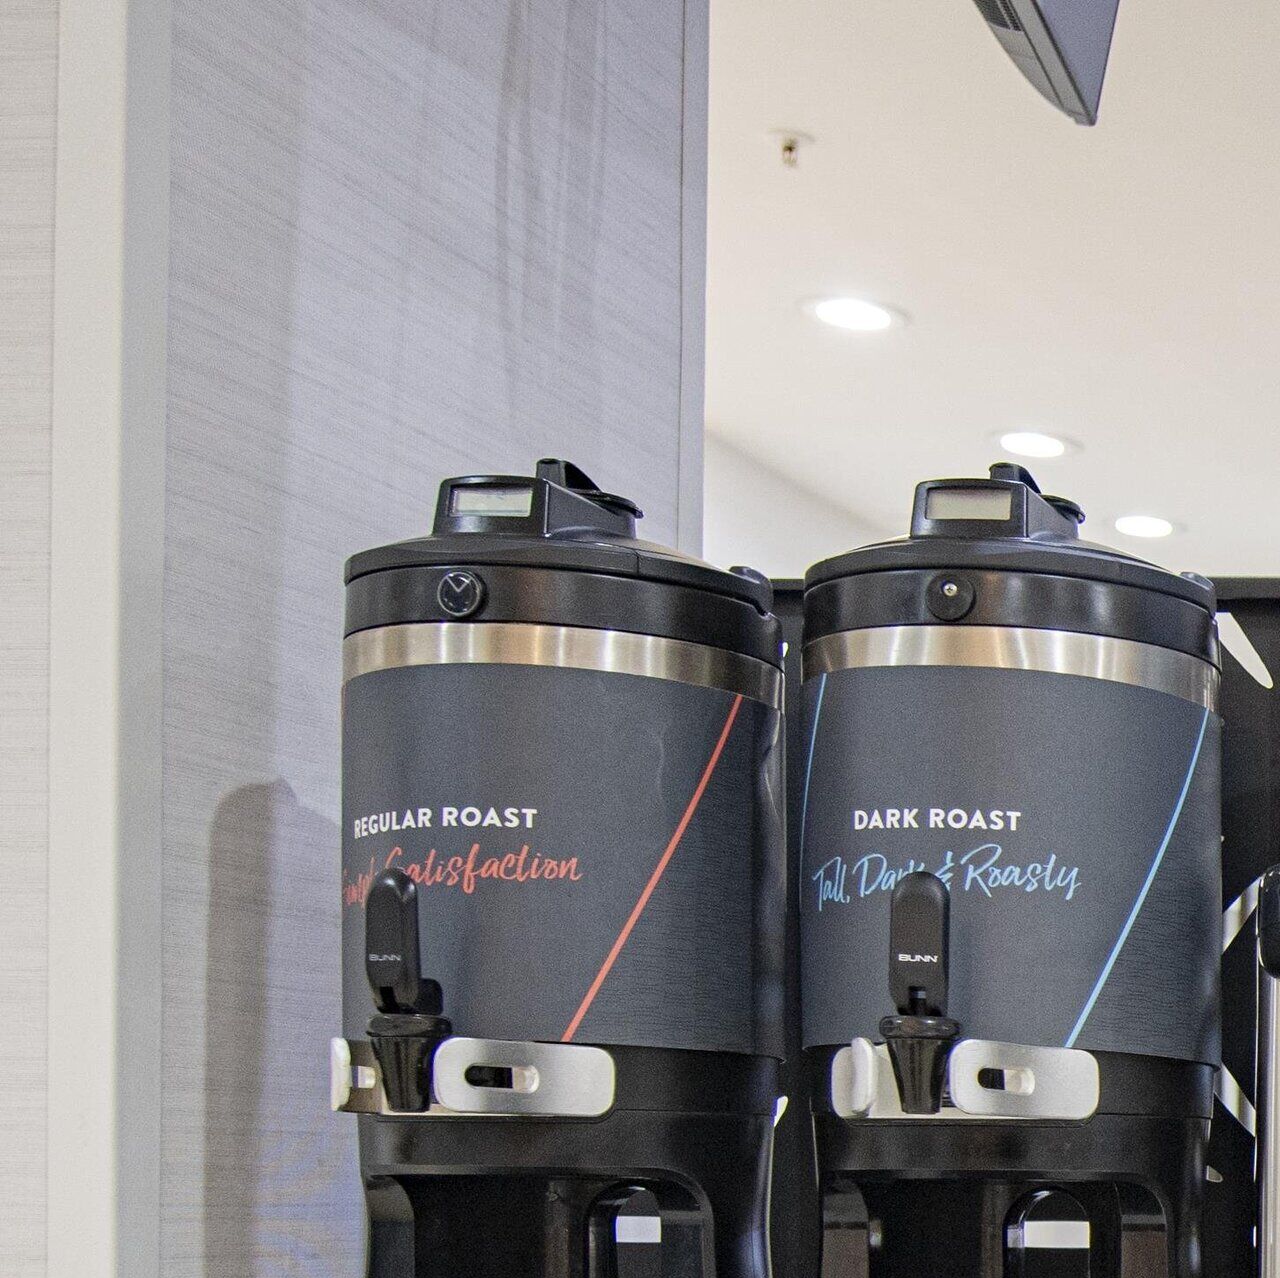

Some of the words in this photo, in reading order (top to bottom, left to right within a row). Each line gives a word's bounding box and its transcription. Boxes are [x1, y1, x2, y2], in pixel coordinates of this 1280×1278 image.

[354, 808, 433, 839] REGULAR
[442, 806, 538, 828] ROAST
[854, 808, 919, 831] DARK
[929, 808, 1021, 831] ROAST
[960, 843, 1081, 900] Roasty
[368, 953, 401, 962] BUNN
[898, 953, 938, 963] BUNN
